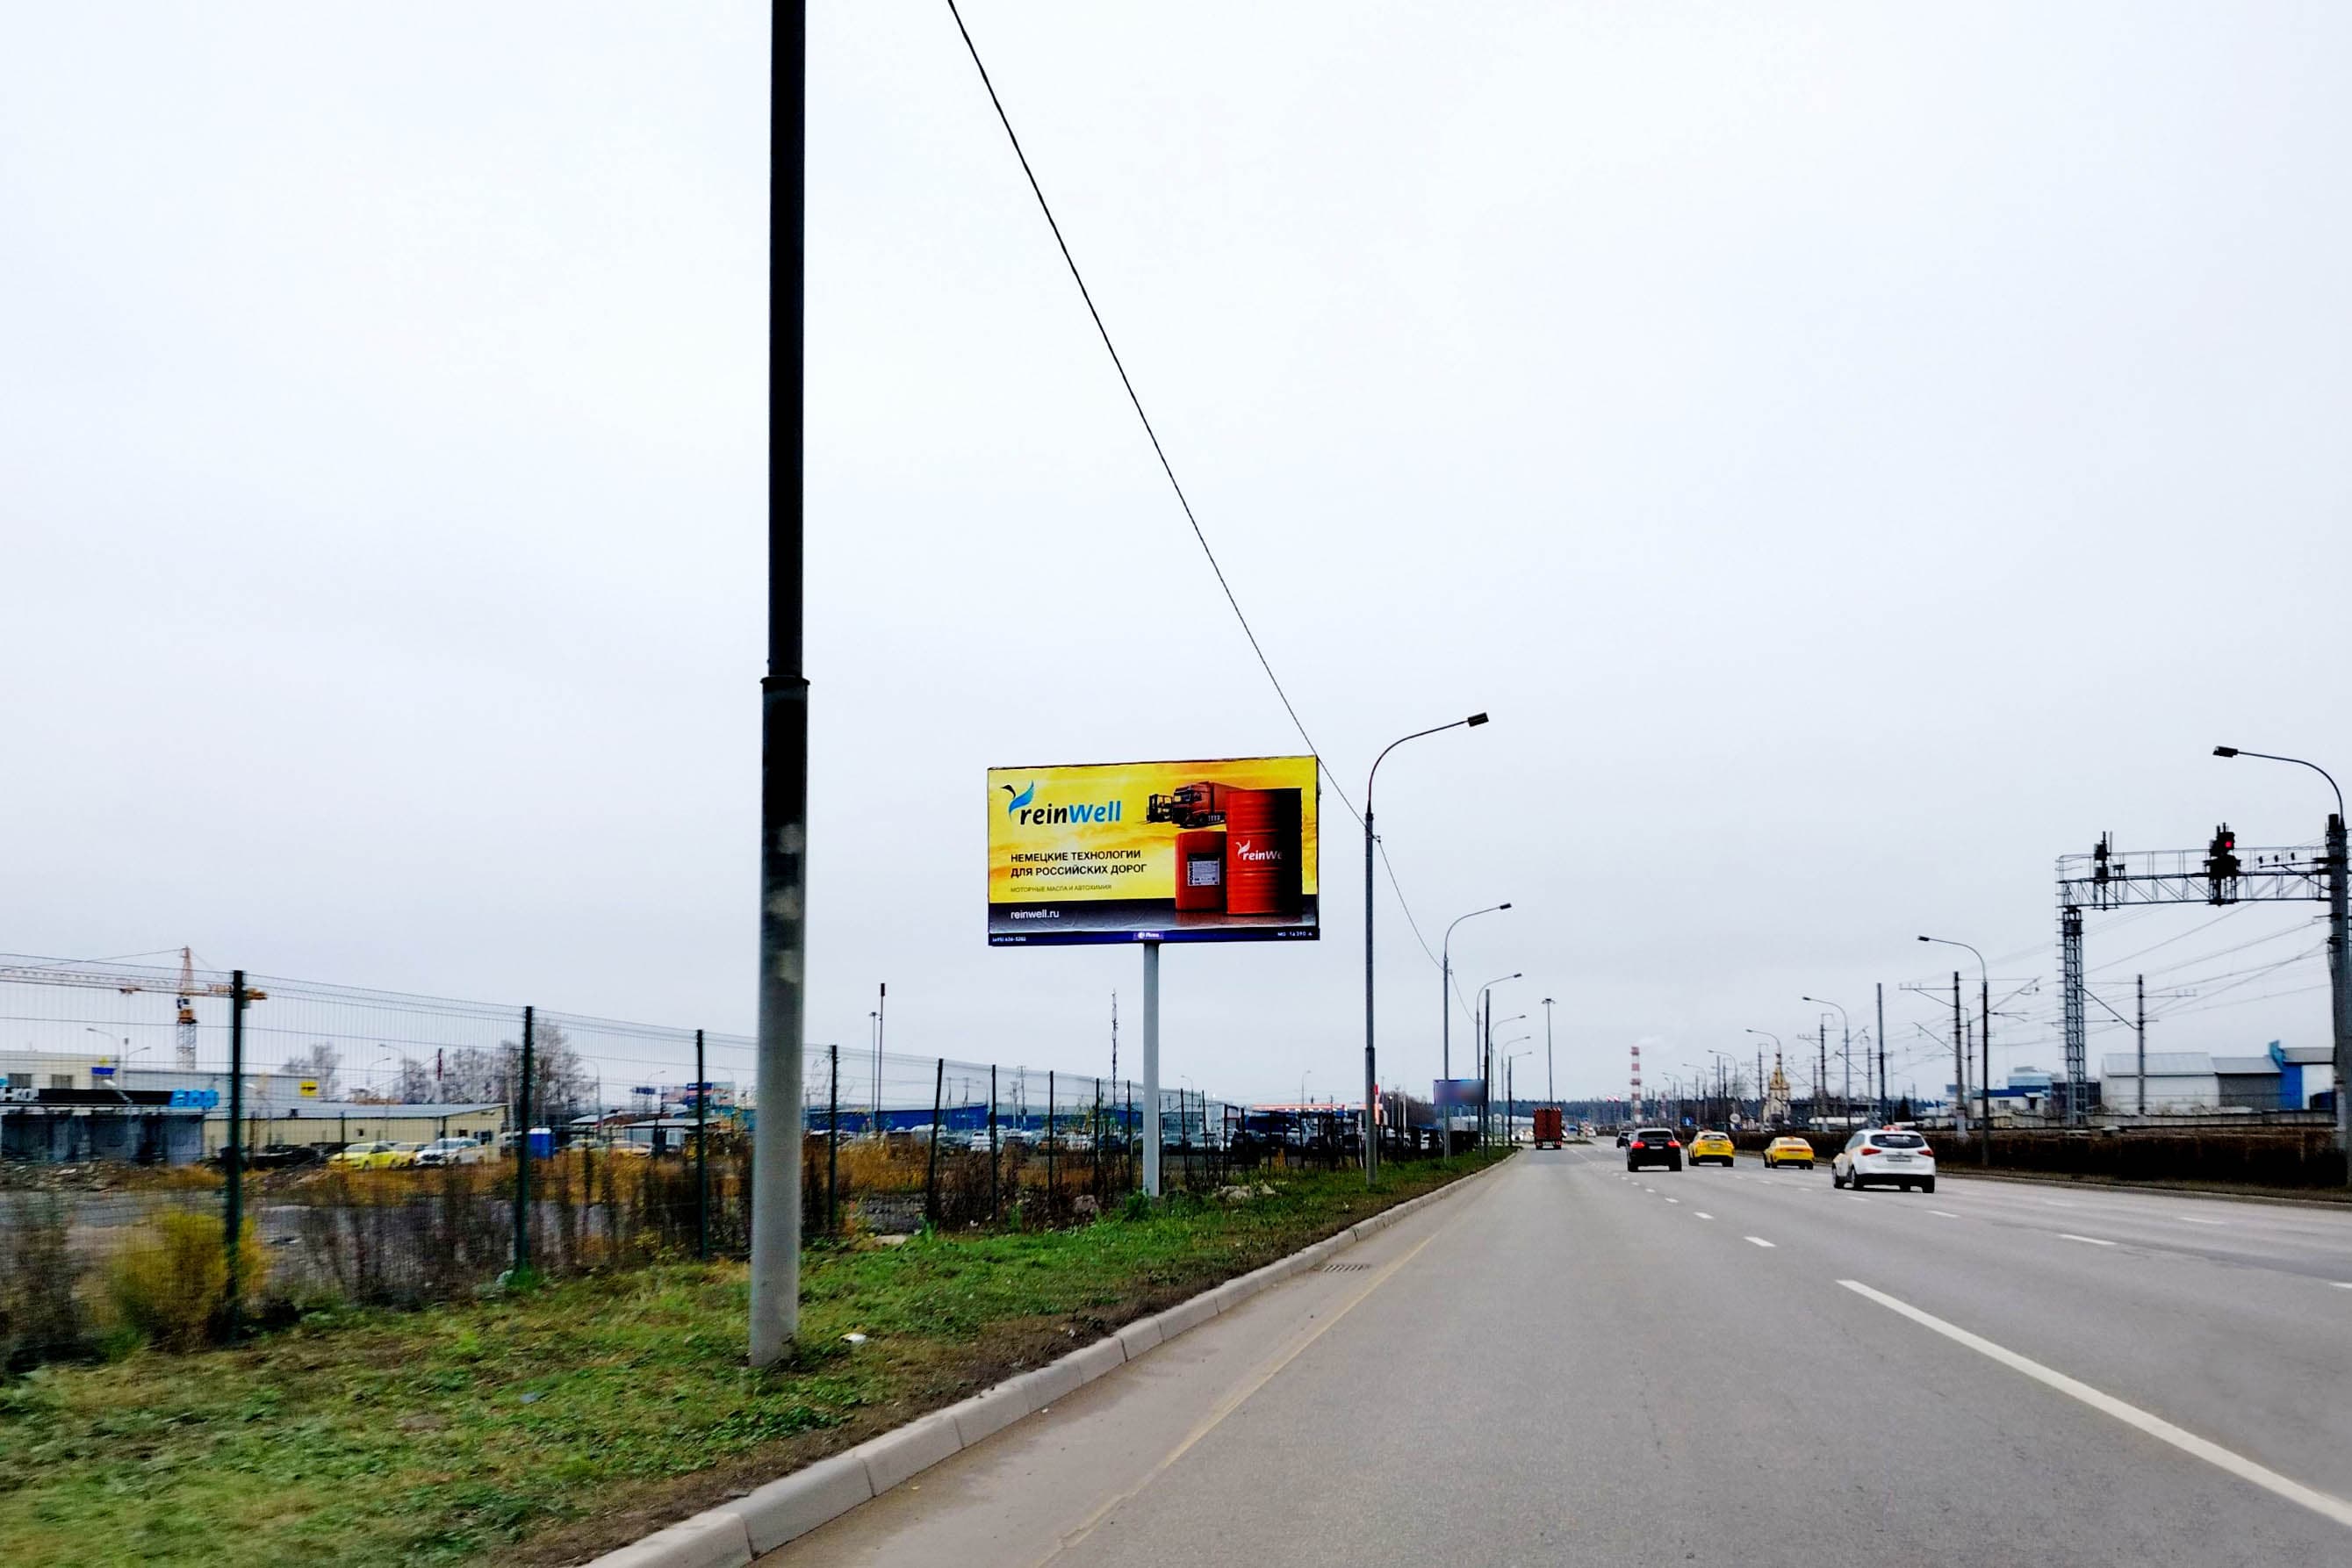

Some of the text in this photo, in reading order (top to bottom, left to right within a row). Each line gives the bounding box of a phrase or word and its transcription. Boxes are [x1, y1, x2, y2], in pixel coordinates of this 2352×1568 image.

[1020, 801, 1120, 825] reinWell
[1011, 849, 1141, 863] НЕМЕЦКИЕ ТЕХНОЛОГИИ
[1011, 863, 1147, 878] ДЛЯ РОССИЙСКИХ ДОРОГ
[1011, 909, 1060, 919] reinwell.ru
